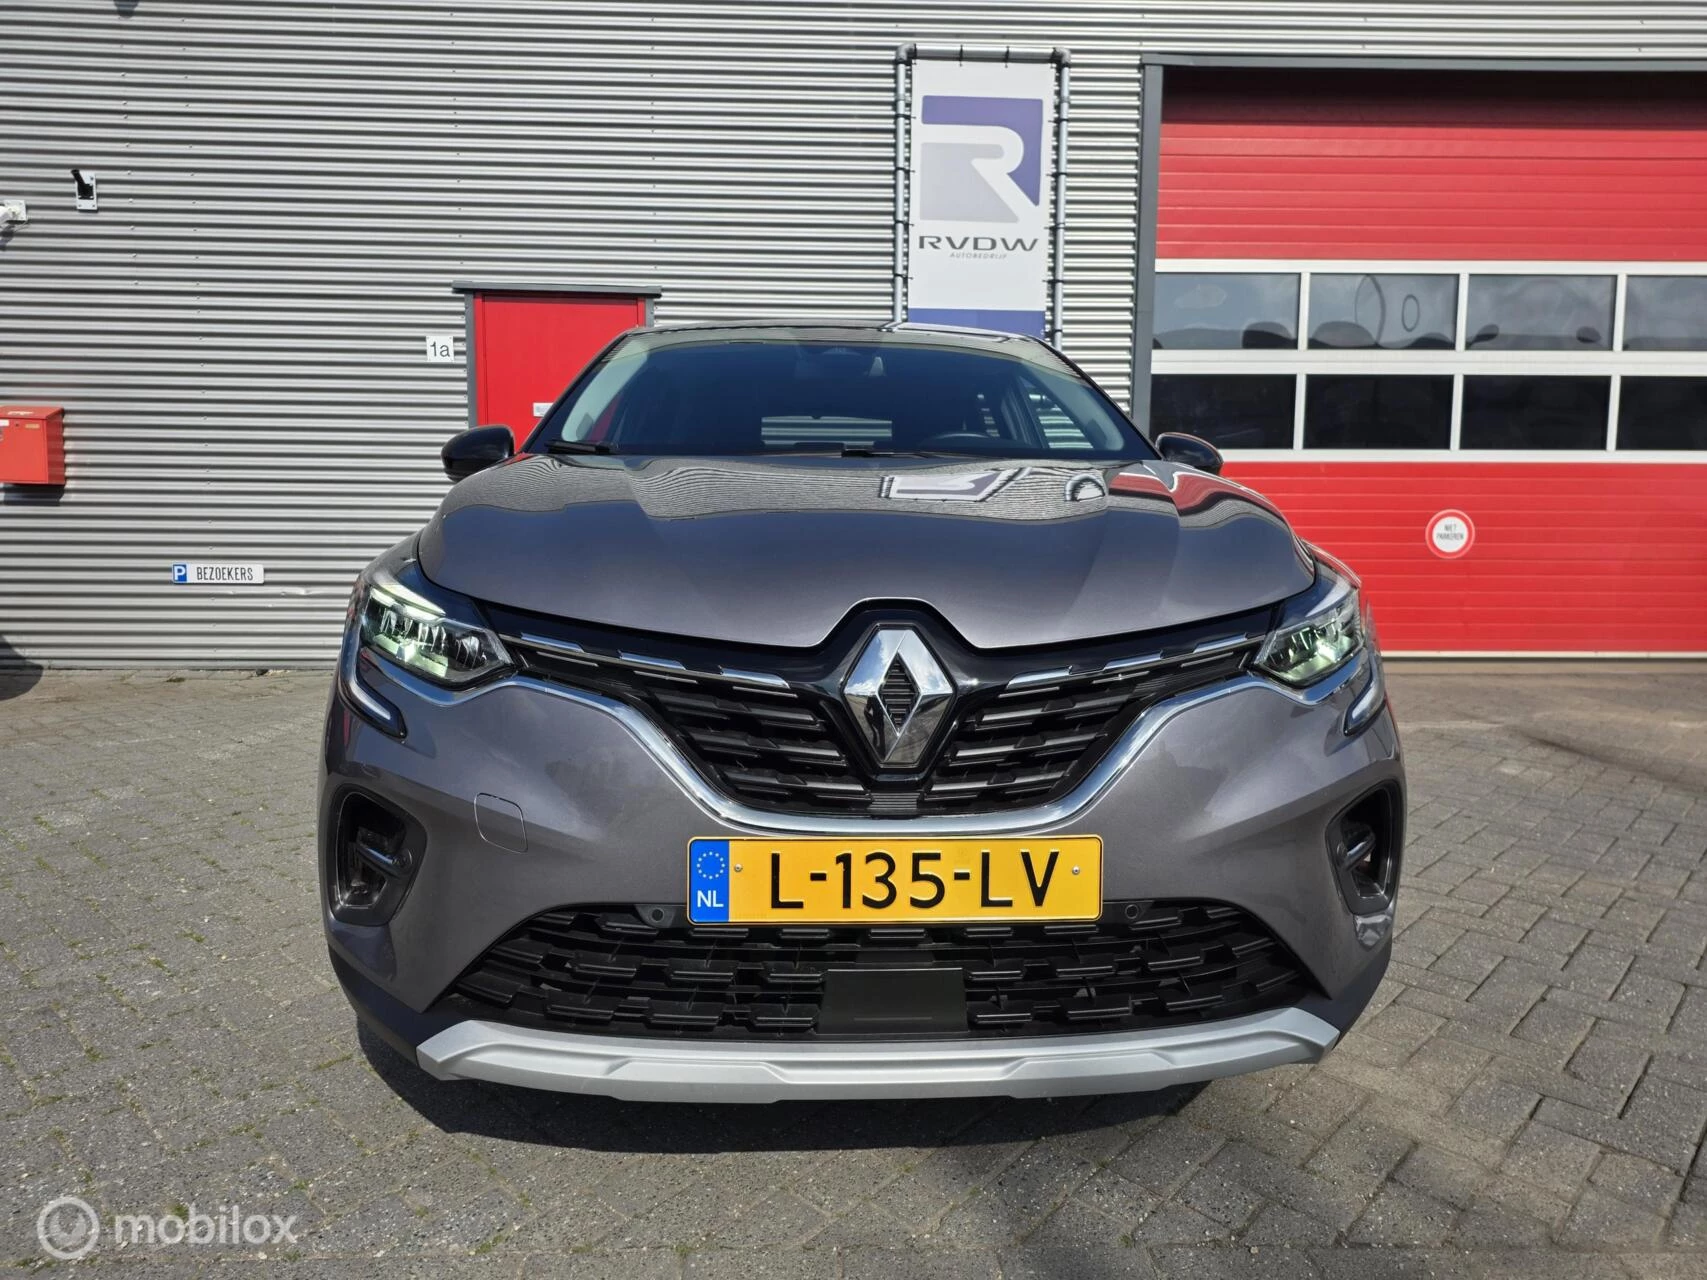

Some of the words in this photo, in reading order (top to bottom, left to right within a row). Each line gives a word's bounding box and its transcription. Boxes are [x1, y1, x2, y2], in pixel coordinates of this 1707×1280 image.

[919, 235, 1038, 251] RVDW
[430, 341, 450, 357] 1a
[174, 565, 185, 580] P
[196, 566, 254, 581] BEZOEKERS
[770, 851, 1060, 909] L-135-LV
[697, 890, 724, 908] NL
